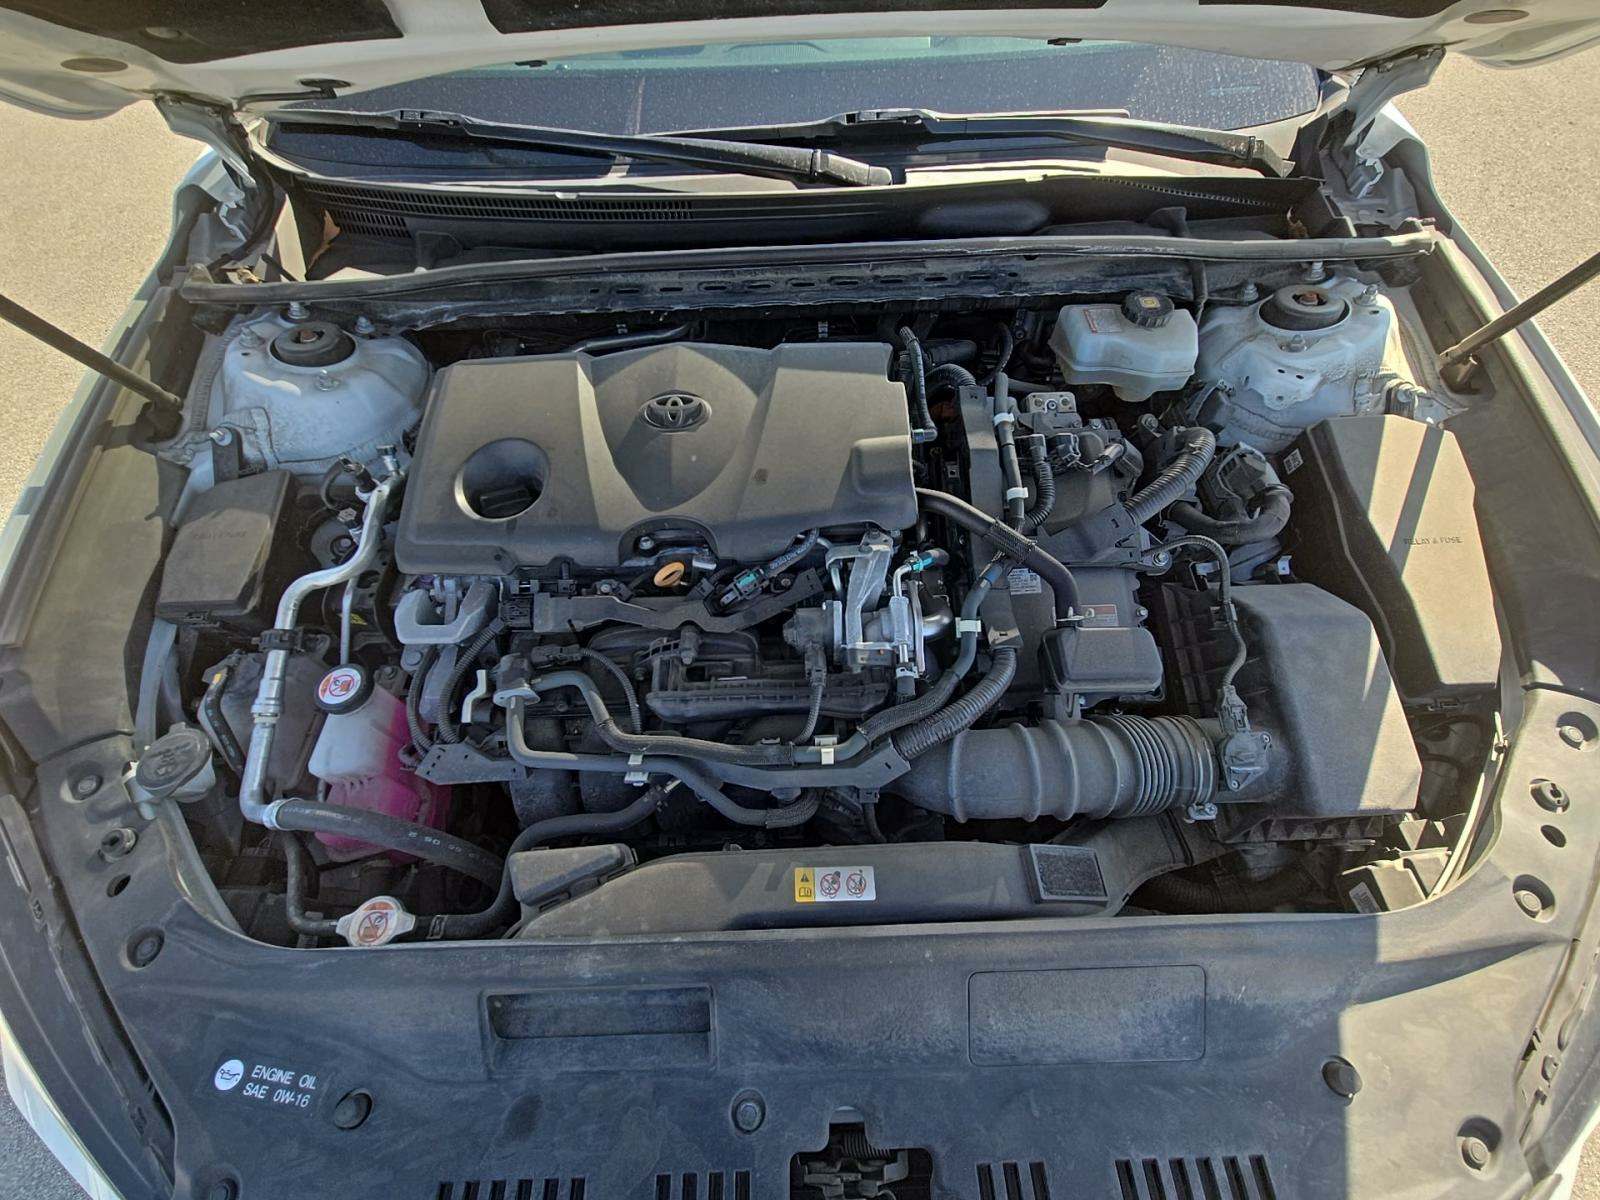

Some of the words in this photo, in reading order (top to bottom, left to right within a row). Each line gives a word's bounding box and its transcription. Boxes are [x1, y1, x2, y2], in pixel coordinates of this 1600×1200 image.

[1440, 536, 1463, 544] FUSE
[251, 1064, 295, 1085] ENGINE
[298, 1074, 317, 1090] OIL
[243, 1082, 270, 1099] SAE
[273, 1089, 311, 1108] 0W-16
